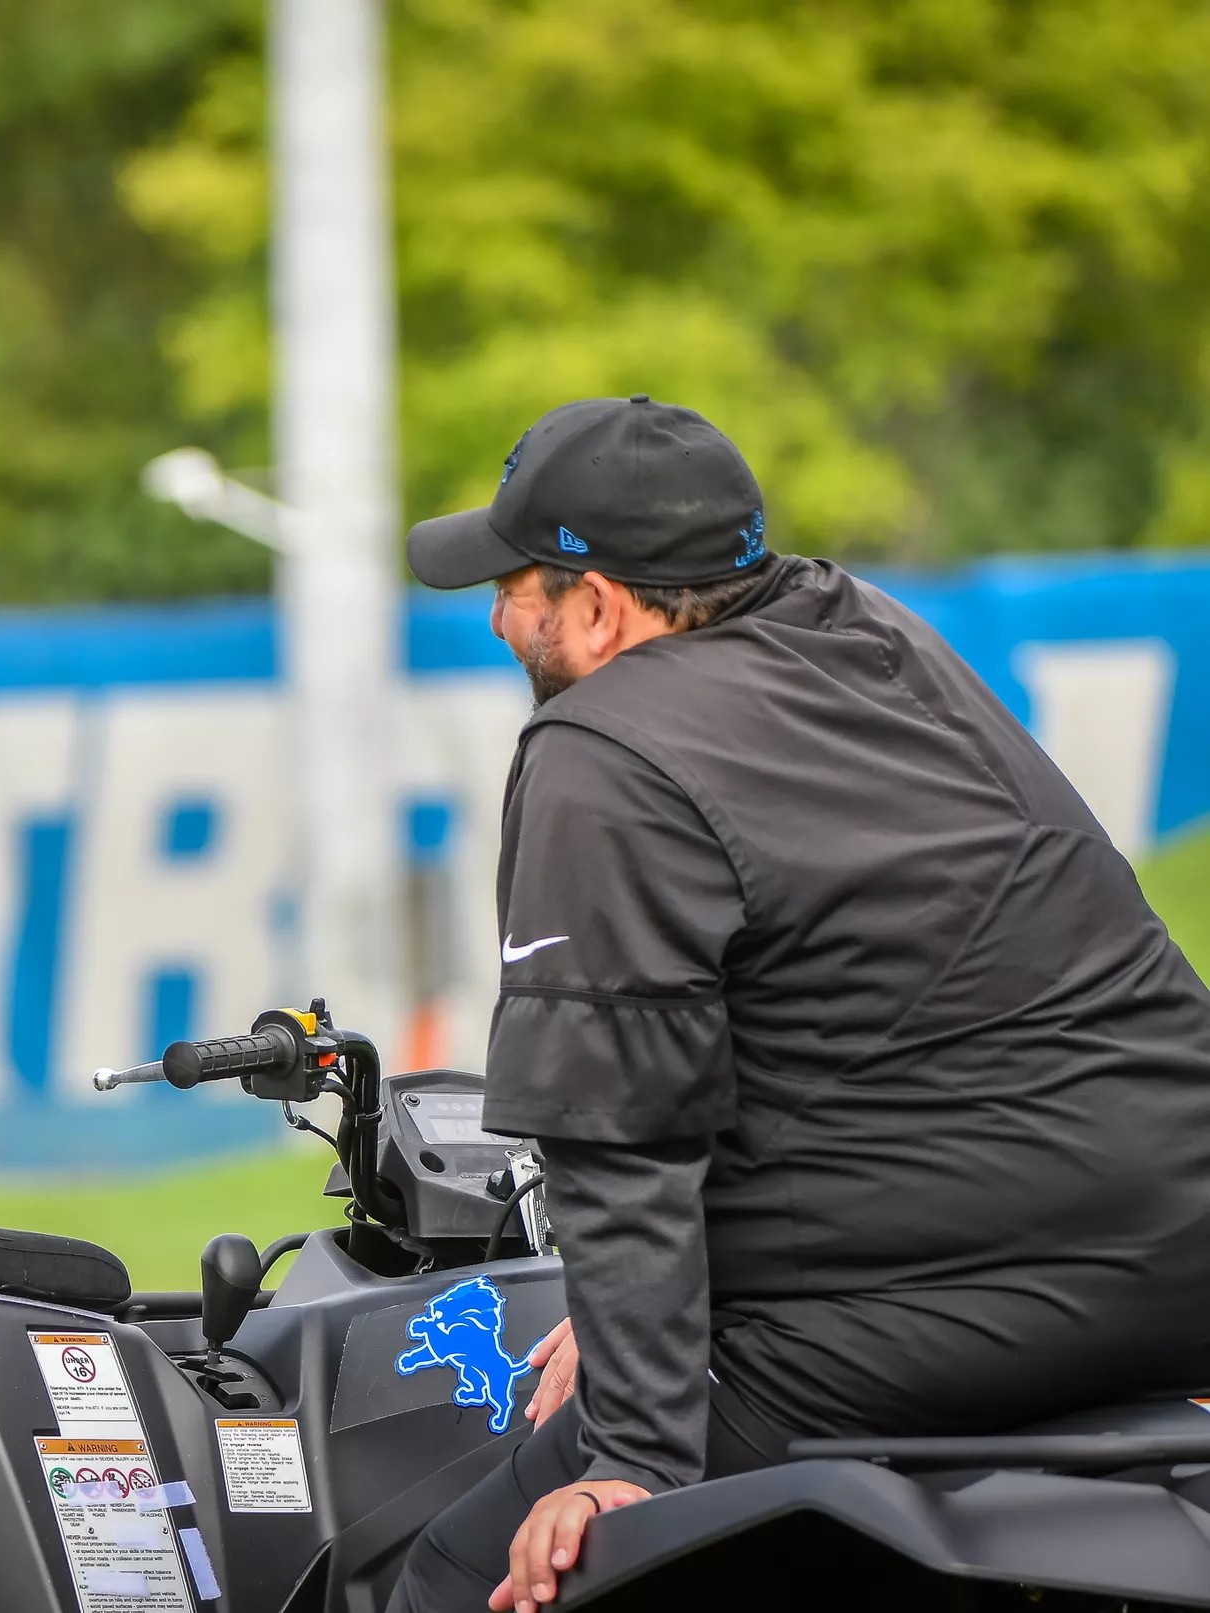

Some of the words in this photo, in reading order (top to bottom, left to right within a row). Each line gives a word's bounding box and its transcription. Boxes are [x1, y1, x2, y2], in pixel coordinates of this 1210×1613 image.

[65, 1356, 90, 1364] UNDER
[73, 1366, 87, 1377] 16
[78, 1443, 118, 1453] WARNING
